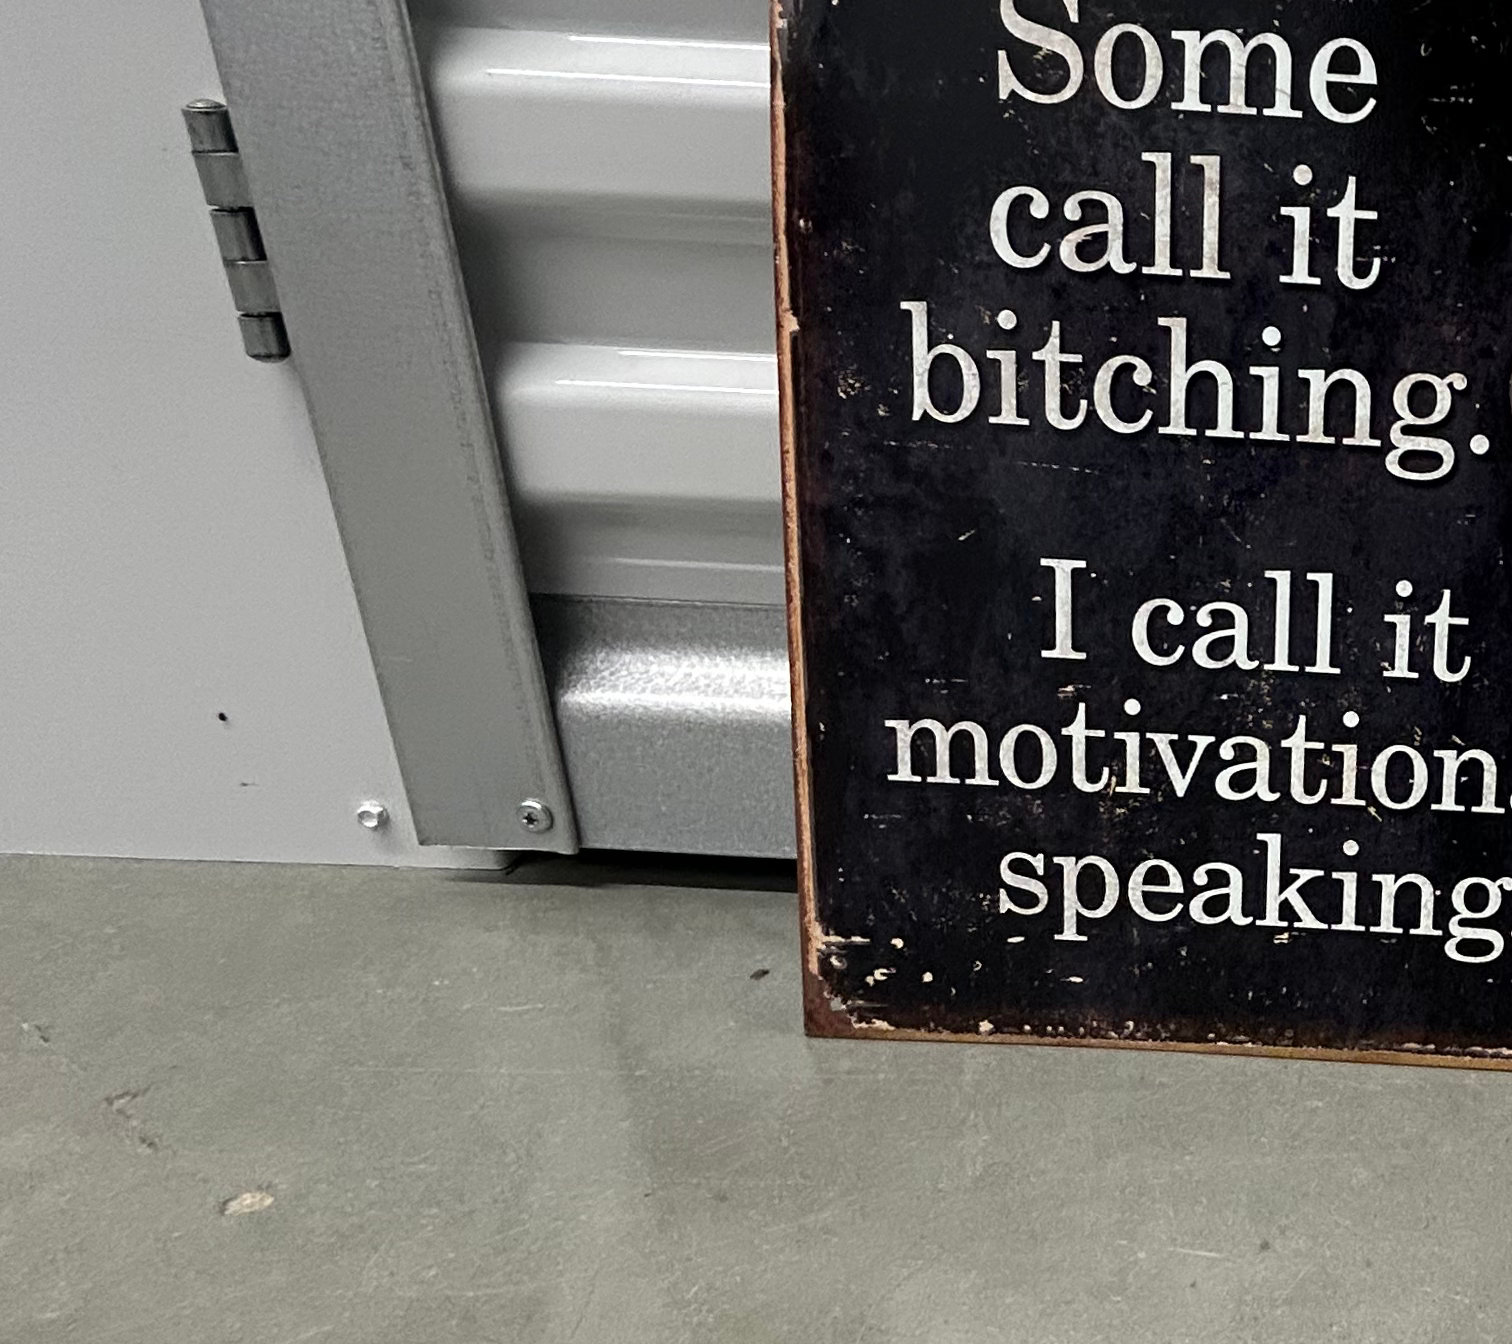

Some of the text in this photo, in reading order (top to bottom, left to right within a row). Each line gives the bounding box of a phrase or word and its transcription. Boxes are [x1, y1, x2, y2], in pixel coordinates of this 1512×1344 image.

[989, 152, 1384, 290] call it
[899, 301, 1490, 481] bitching.
[1039, 557, 1473, 683] I call it
